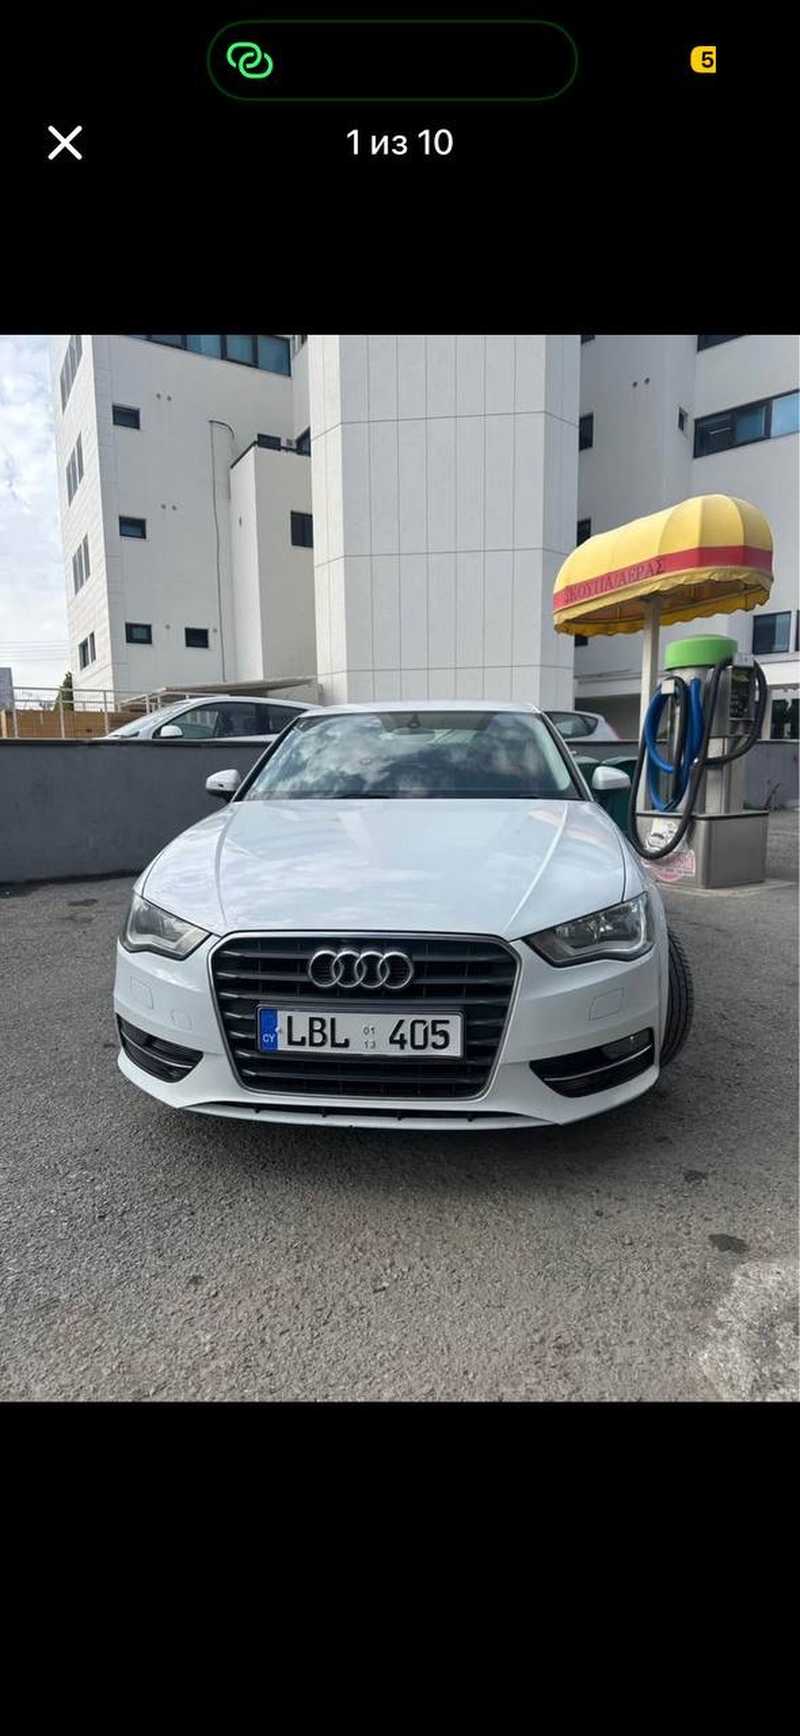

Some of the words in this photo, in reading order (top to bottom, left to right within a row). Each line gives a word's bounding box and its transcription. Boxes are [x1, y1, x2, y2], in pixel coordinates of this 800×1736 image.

[262, 1033, 276, 1044] CY
[286, 1015, 350, 1049] LBL
[388, 1019, 451, 1051] 405
